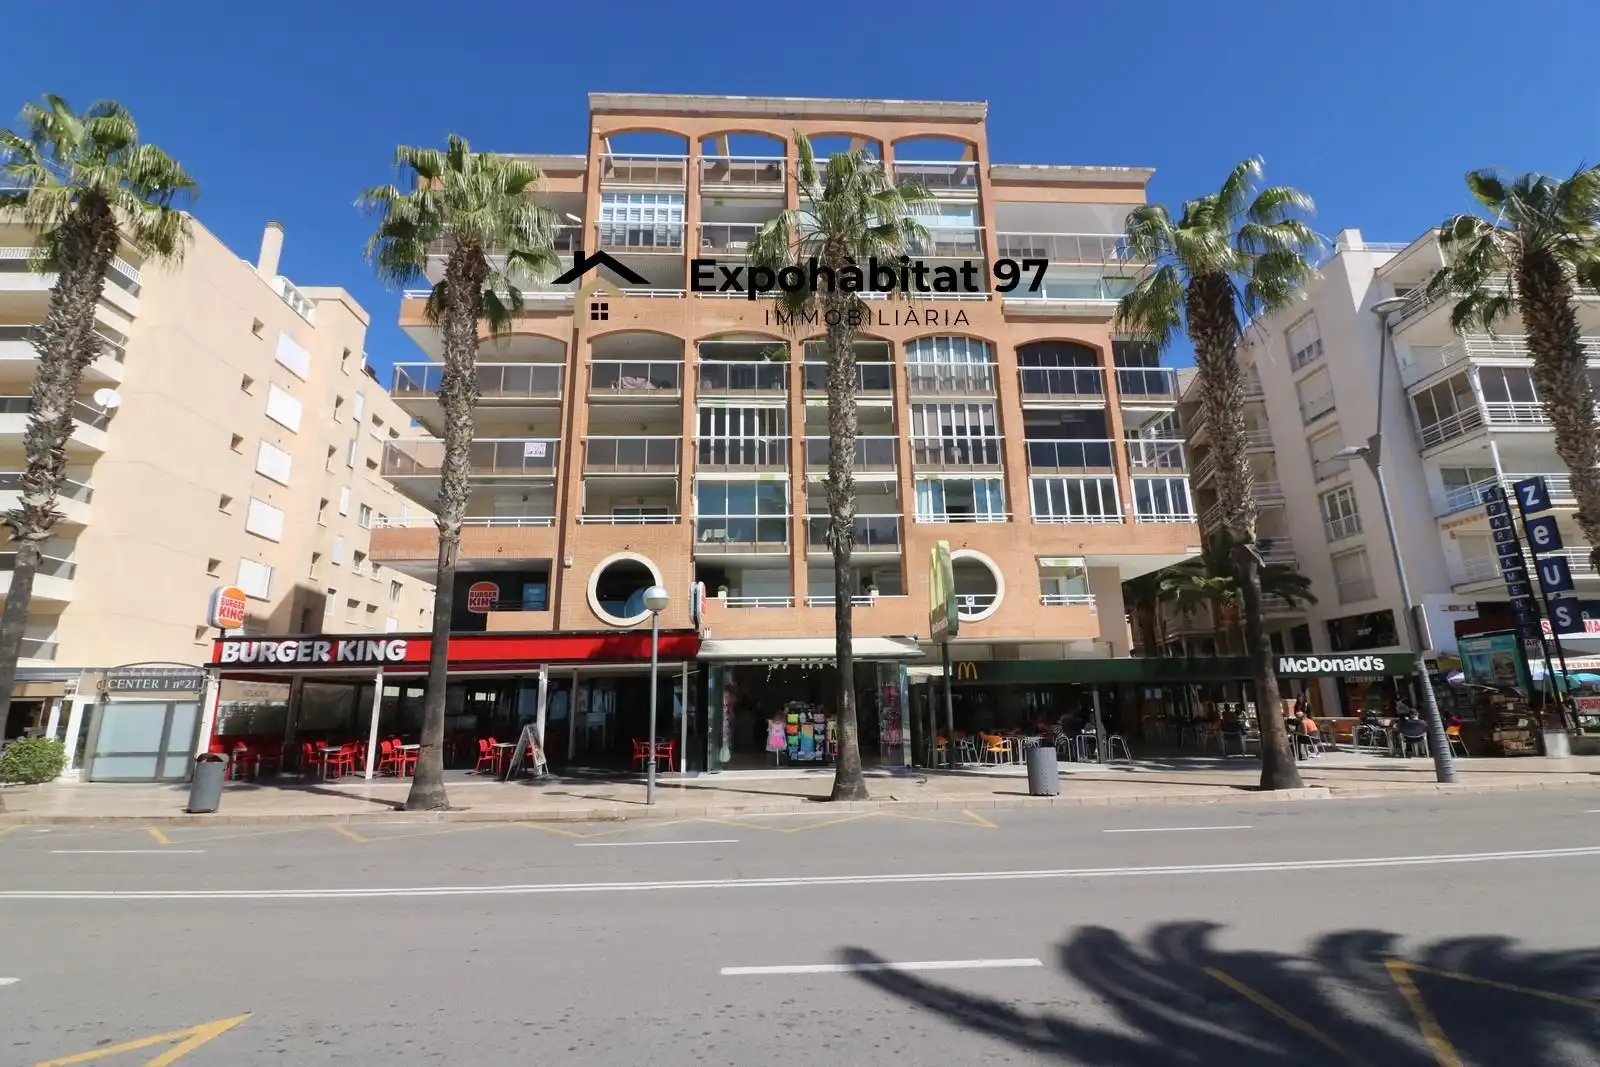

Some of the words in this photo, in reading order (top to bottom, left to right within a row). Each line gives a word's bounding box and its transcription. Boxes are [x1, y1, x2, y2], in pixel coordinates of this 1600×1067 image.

[220, 597, 245, 610] BURGER
[219, 606, 244, 621] KING
[221, 640, 331, 663] BURGER
[337, 639, 407, 662] KING
[1279, 656, 1385, 673] McDonald's
[107, 679, 159, 690] CENTER
